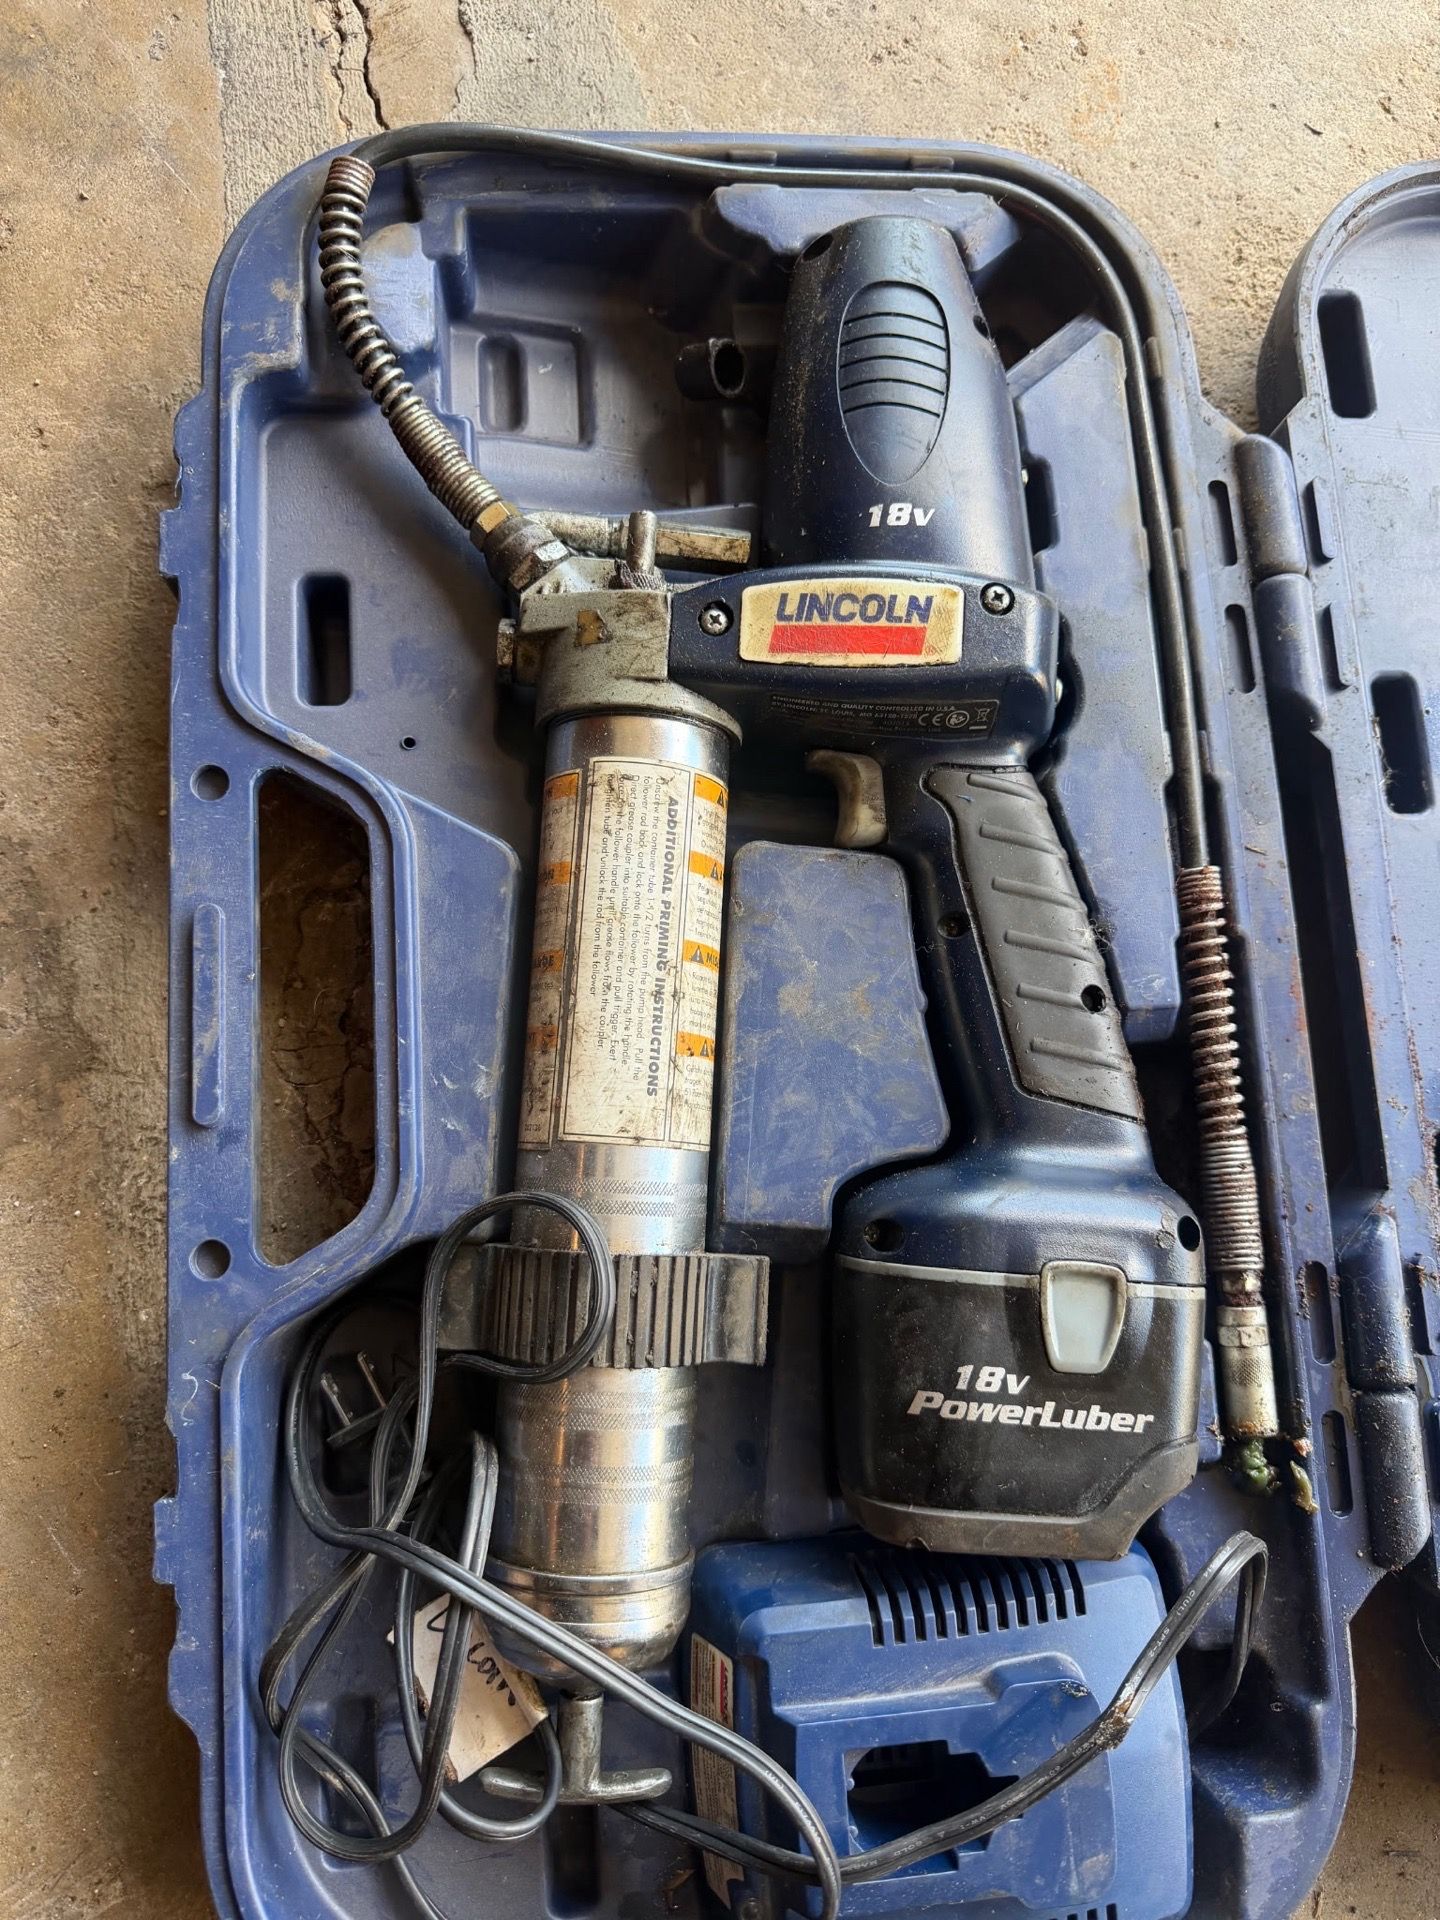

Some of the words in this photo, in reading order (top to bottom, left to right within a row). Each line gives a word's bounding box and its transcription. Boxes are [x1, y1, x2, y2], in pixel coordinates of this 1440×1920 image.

[776, 592, 934, 624] LINCOLN
[840, 703, 873, 711] QUALITY
[629, 775, 640, 802] Direct
[641, 775, 653, 810] follower
[653, 777, 662, 814] Unscrew
[602, 815, 613, 835] tube
[615, 811, 625, 825] the
[627, 802, 637, 831] grease
[640, 812, 649, 828] rod
[652, 815, 661, 830] the
[601, 836, 610, 854] and
[611, 827, 623, 862] follower
[623, 832, 633, 863] coupler
[639, 829, 648, 849] back
[661, 795, 679, 895] ADDITIONAL
[637, 851, 646, 869] and
[649, 832, 658, 872] container
[598, 856, 609, 885] unlock
[609, 864, 619, 894] handle
[622, 863, 631, 884] into
[636, 871, 645, 889] lock
[597, 887, 607, 902] the
[647, 873, 656, 894] tube
[595, 903, 605, 919] rod
[620, 886, 631, 920] suitable
[634, 889, 642, 911] onto
[593, 920, 604, 942] from
[632, 913, 642, 927] the
[604, 918, 615, 948] grease
[617, 922, 627, 963] container
[644, 924, 653, 946] turns
[656, 899, 672, 972] PRIMING
[592, 943, 602, 958] the
[629, 929, 640, 967] follower
[642, 948, 652, 970] from
[603, 950, 613, 973] flows
[626, 966, 638, 979] by
[589, 961, 601, 997] follower
[615, 965, 623, 983] and
[640, 971, 650, 986] the
[599, 998, 610, 1013] the
[611, 985, 622, 1005] pull
[623, 980, 635, 1016] rotating
[635, 987, 646, 1015] pump
[624, 1017, 633, 1032] the
[646, 977, 667, 1097] INSTRUCTIONS
[608, 1039, 619, 1061] Exert
[634, 1048, 644, 1064] Pull
[632, 1066, 641, 1081] the
[906, 1390, 1155, 1433] PowerLuber
[1148, 1627, 1171, 1658] SPT-2
